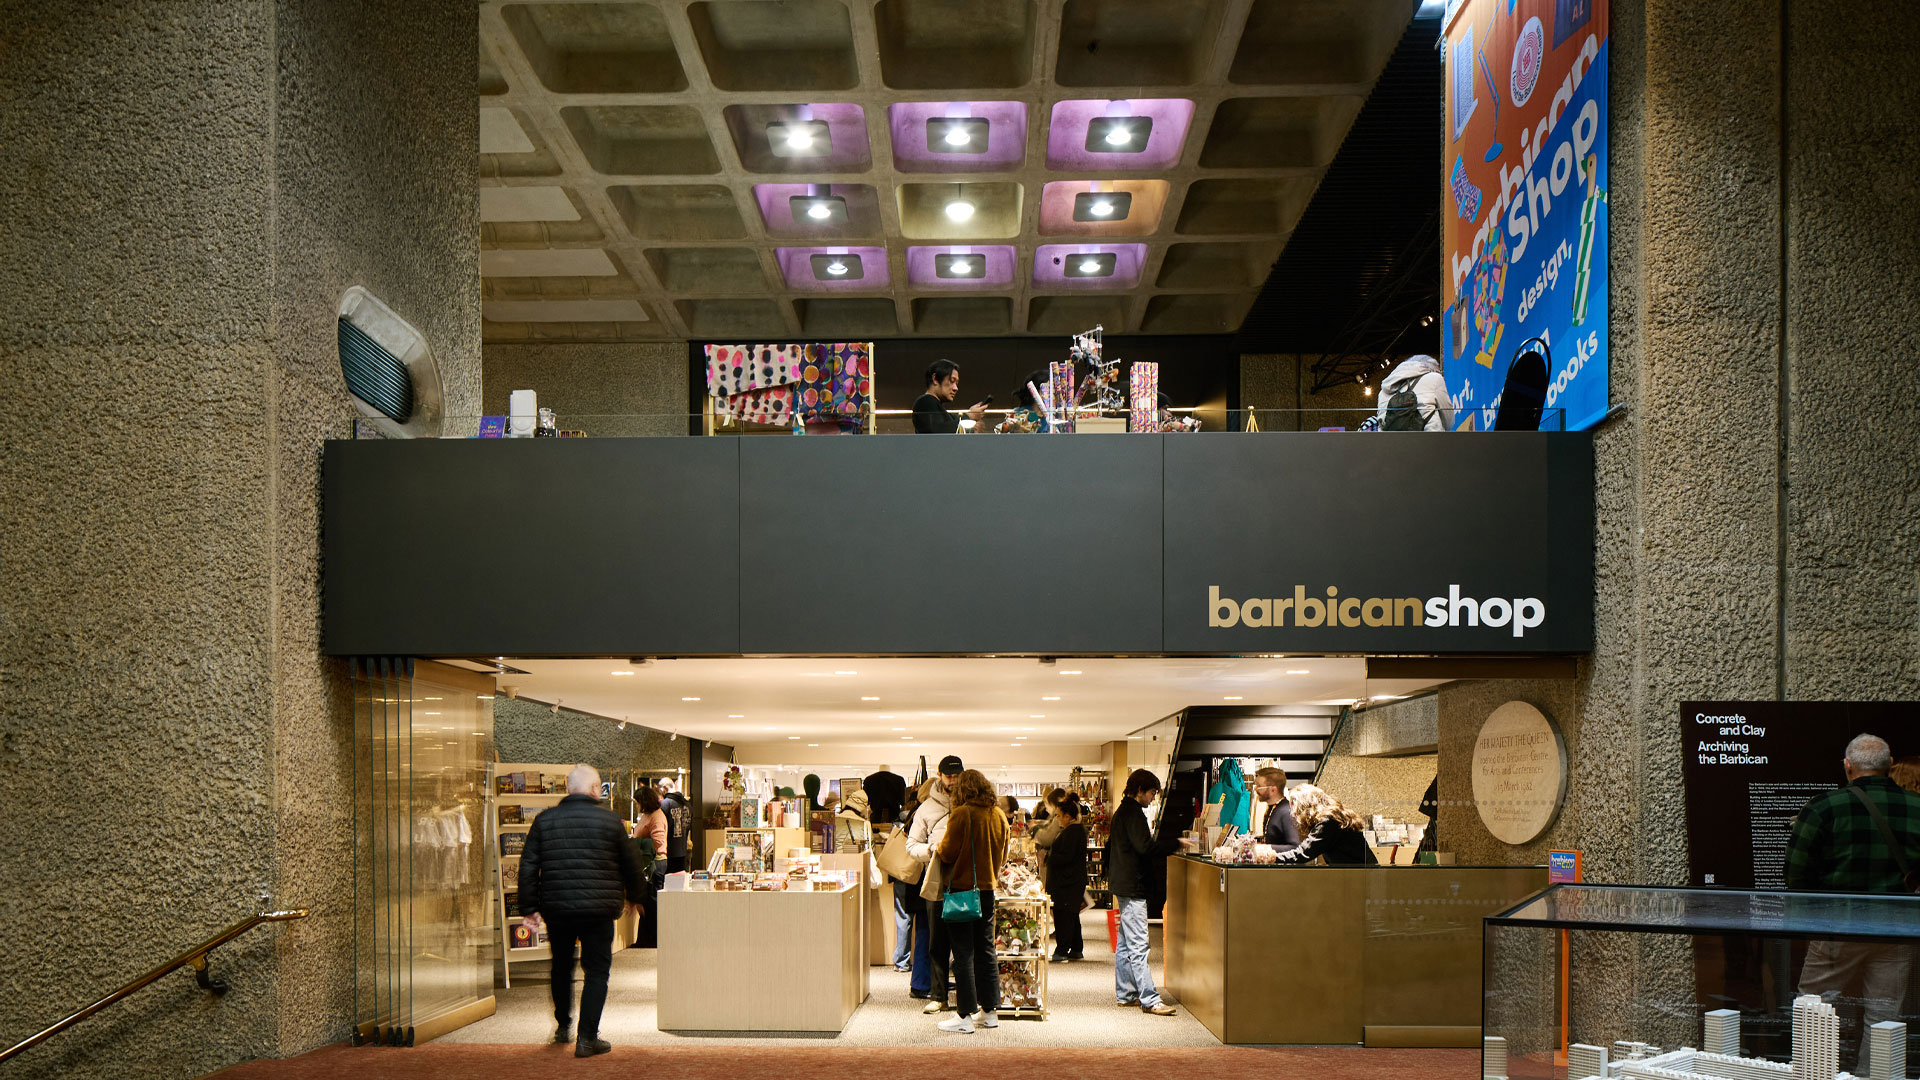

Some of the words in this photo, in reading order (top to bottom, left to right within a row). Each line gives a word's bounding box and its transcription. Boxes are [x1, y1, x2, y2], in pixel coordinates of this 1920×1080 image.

[1517, 238, 1573, 323] design,
[1547, 330, 1598, 408] books
[1696, 713, 1746, 724] Concrete
[1720, 725, 1740, 735] and
[1741, 725, 1765, 737] Clay
[1514, 734, 1526, 747] THE
[1526, 731, 1549, 748] QUEEN
[1698, 741, 1749, 753] Archiving
[1698, 754, 1717, 764] the
[1720, 754, 1768, 764] Barbican
